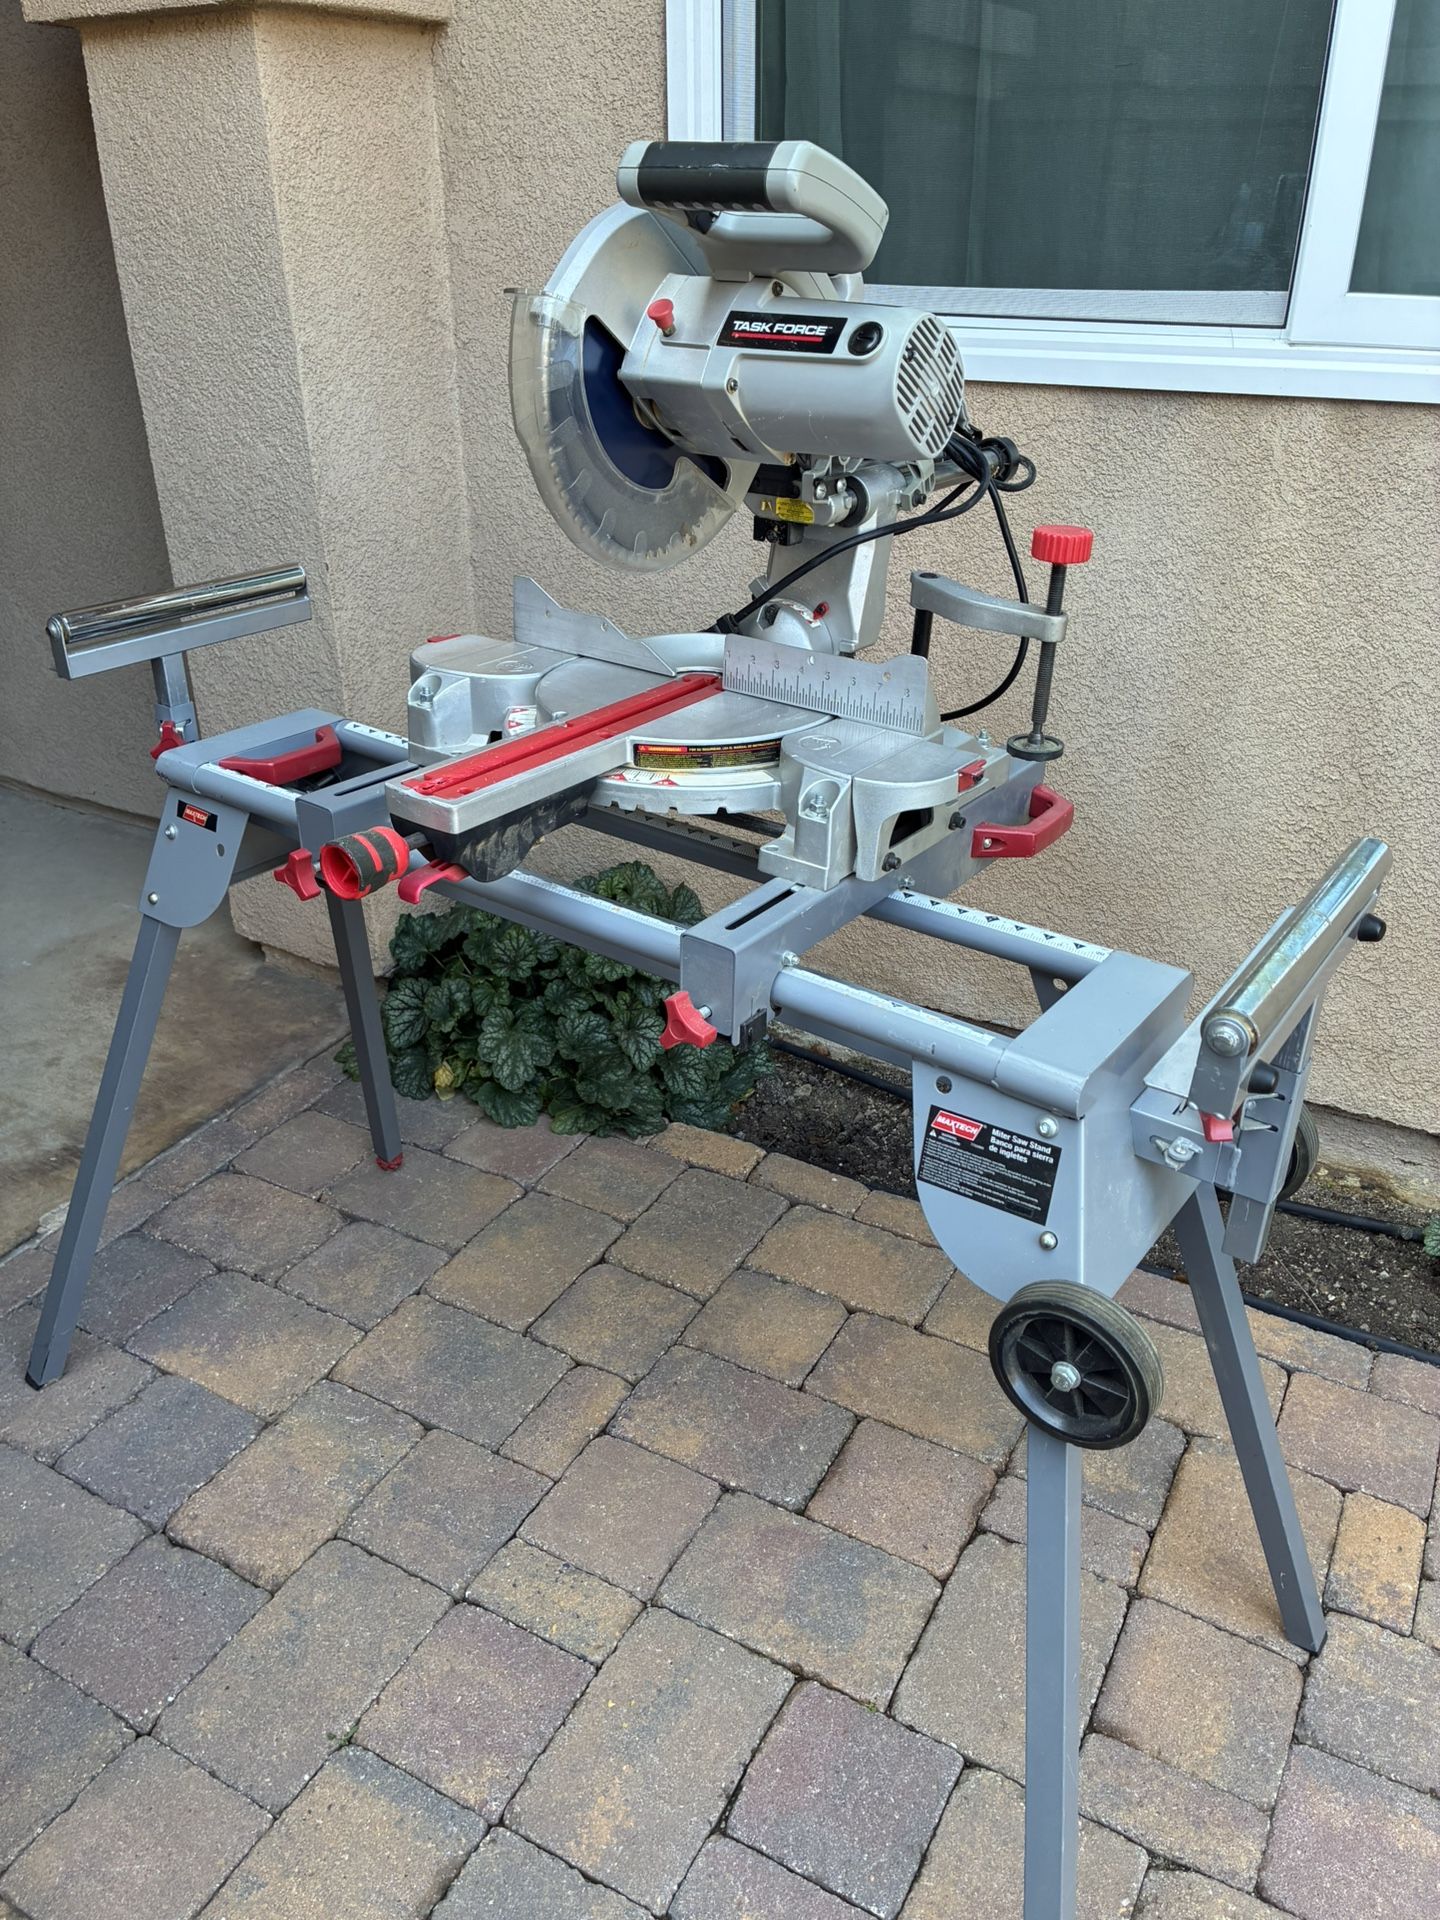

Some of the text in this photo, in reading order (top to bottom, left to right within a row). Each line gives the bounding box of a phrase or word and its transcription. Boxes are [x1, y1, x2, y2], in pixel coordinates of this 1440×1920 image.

[733, 321, 828, 336] TASK FORCE
[937, 1115, 978, 1134] MAXTECH
[990, 1136, 1013, 1150] Banco
[1013, 1144, 1031, 1156] para
[1032, 1150, 1054, 1163] sierra
[991, 1128, 1052, 1154] Miter Saw Stand
[988, 1144, 998, 1153] de
[999, 1146, 1028, 1163] ingletes
